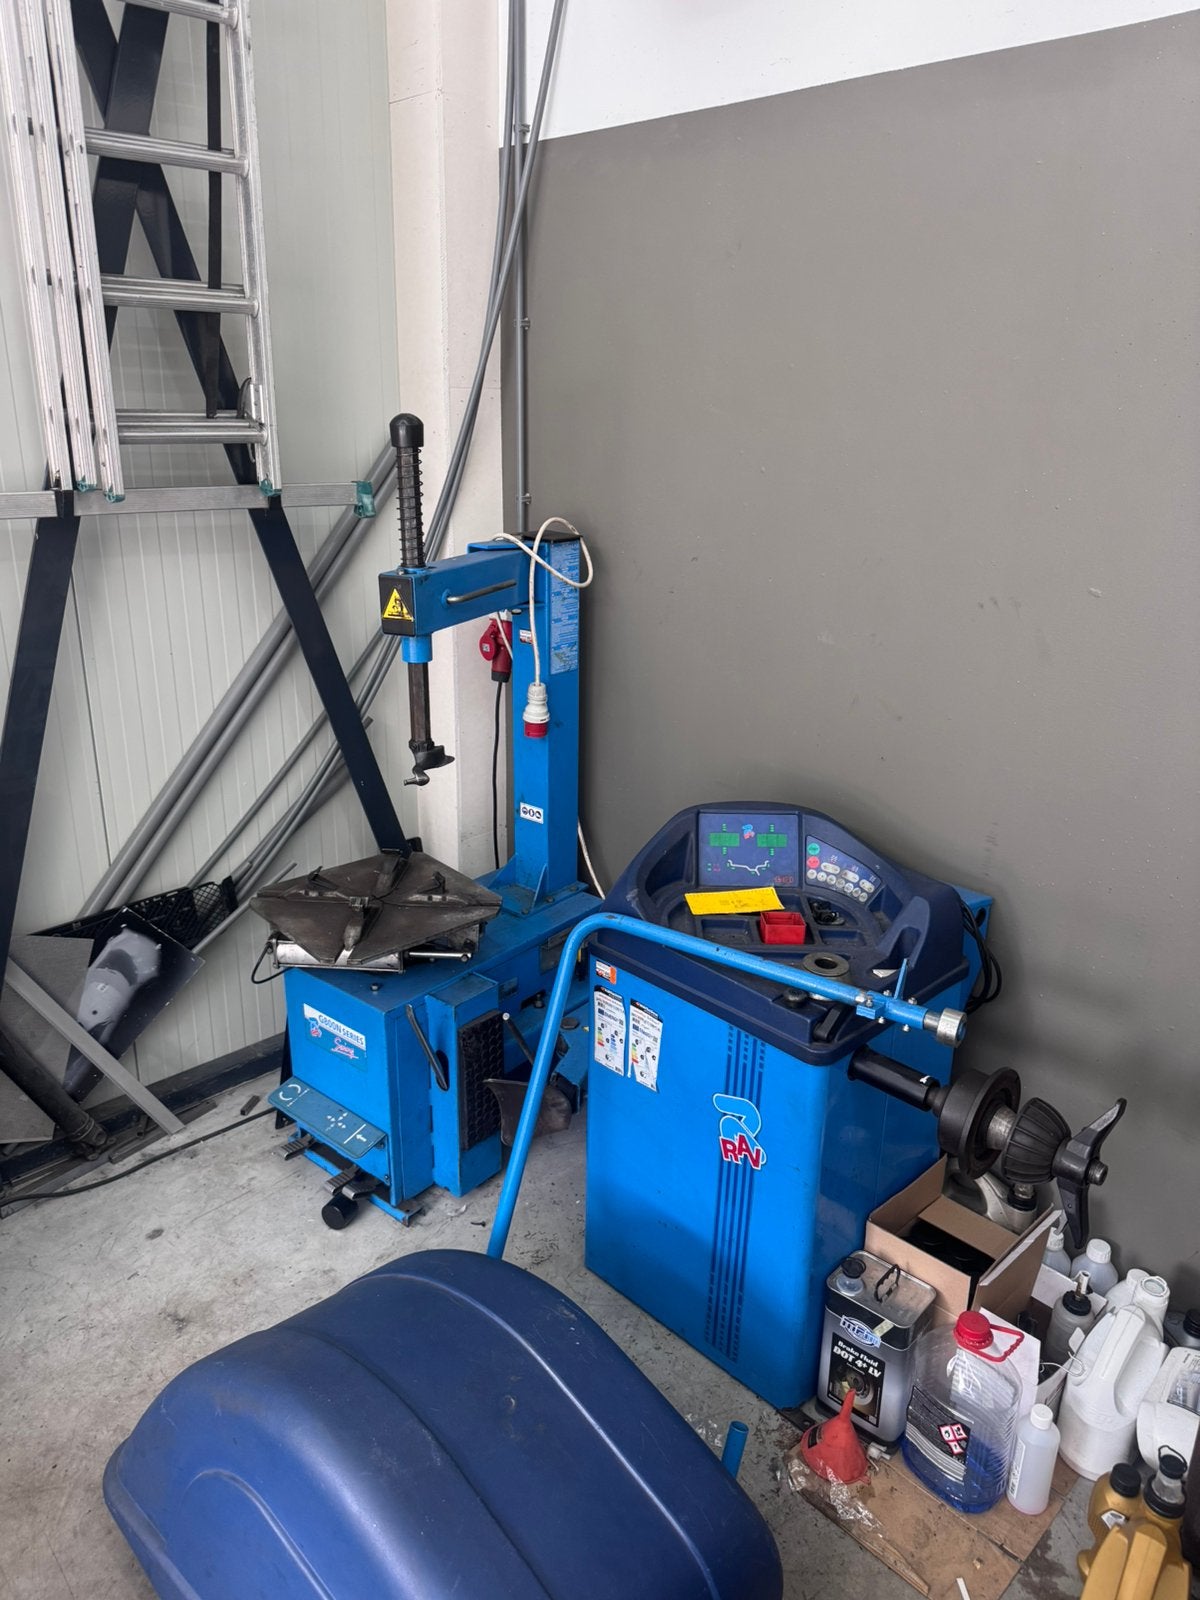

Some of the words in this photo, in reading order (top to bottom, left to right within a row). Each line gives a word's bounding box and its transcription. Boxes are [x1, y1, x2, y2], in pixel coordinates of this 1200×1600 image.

[719, 1132, 761, 1170] RAV
[833, 1346, 855, 1362] DOT
[868, 1366, 882, 1378] LV
[838, 1341, 860, 1357] Brake
[860, 1353, 879, 1367] Fluid
